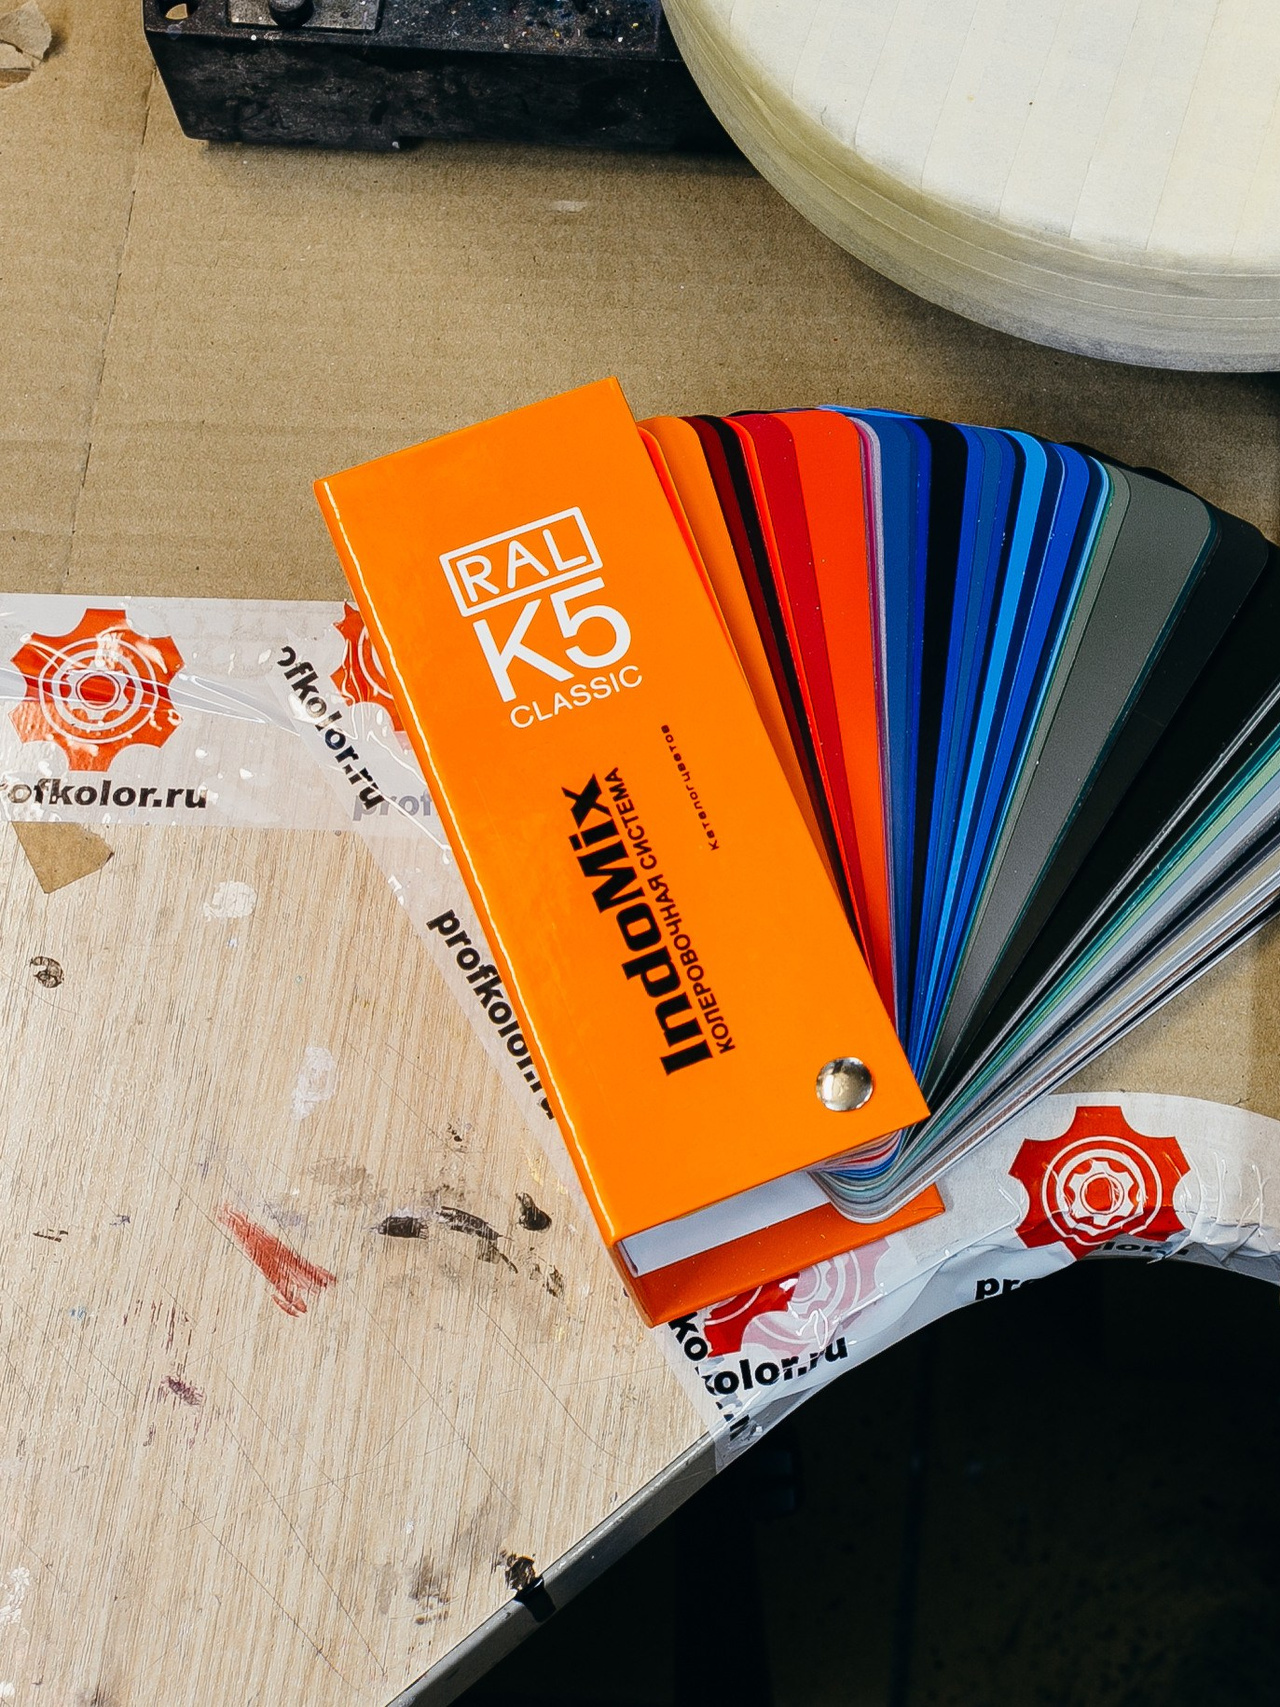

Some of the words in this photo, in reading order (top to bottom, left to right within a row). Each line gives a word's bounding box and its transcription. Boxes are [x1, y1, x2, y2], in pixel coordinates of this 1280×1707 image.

[456, 529, 587, 603] RAL
[472, 577, 632, 703] K5
[510, 664, 643, 729] CLASSIC
[0, 778, 207, 808] ofkolor.ru
[604, 766, 657, 871] СИСТЕМА
[561, 772, 713, 1076] IndoMix
[647, 873, 736, 1054] КОЛЕРОВОЧНАЯ
[702, 1336, 849, 1397] olor.ru
